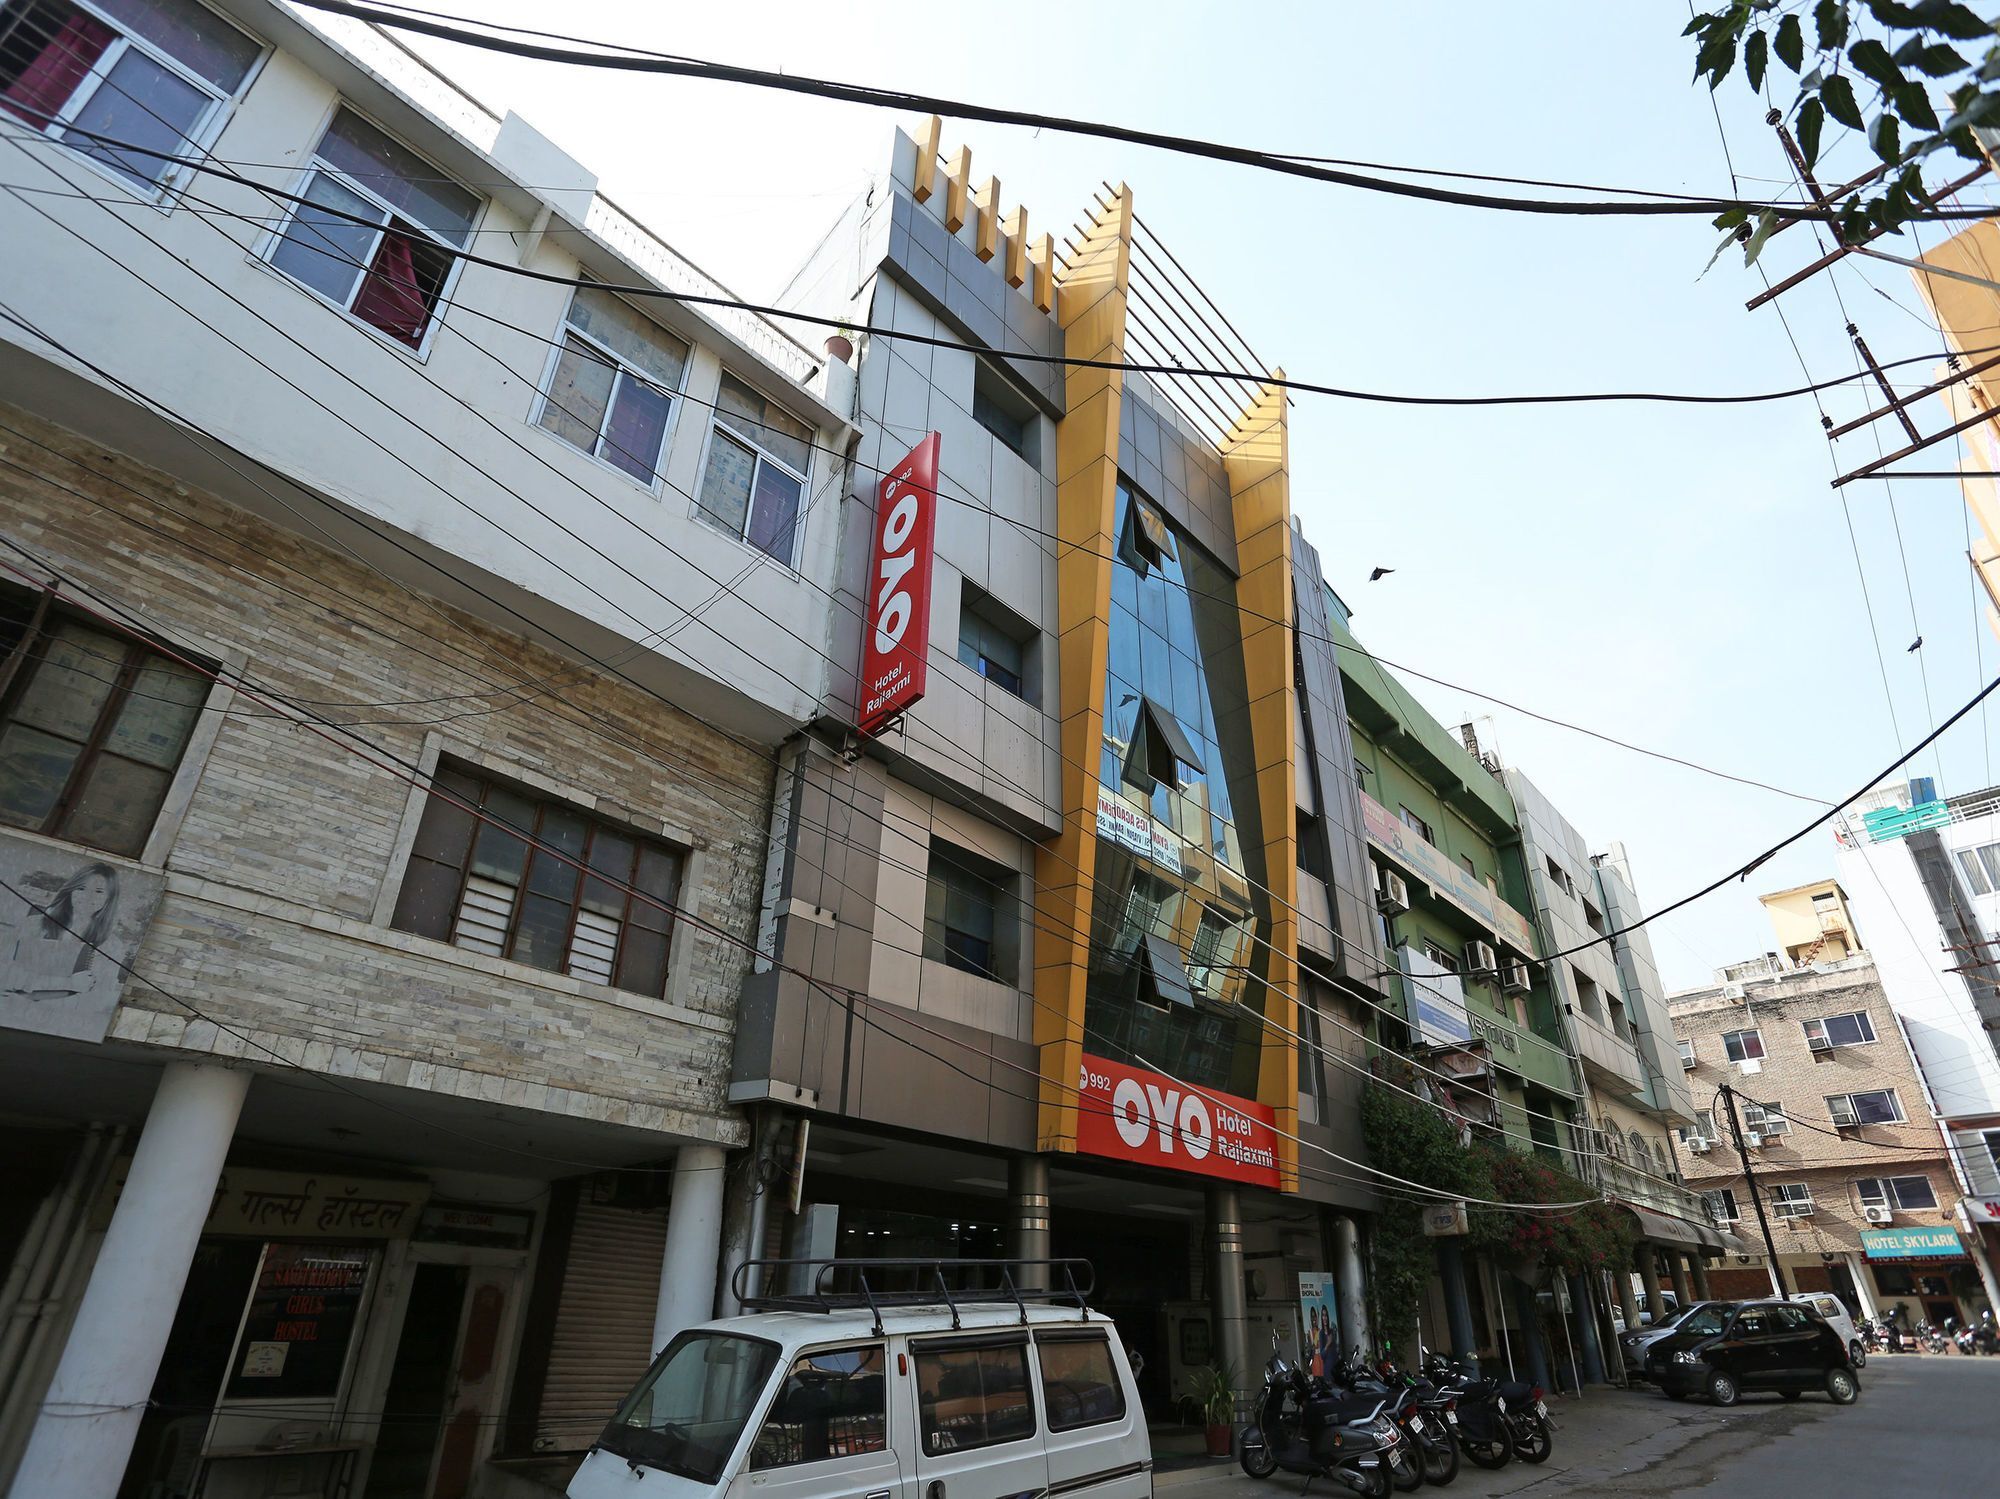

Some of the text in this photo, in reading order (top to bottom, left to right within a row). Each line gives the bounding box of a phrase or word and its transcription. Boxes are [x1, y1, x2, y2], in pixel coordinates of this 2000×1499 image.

[897, 466, 913, 487] 992
[874, 494, 919, 655] OYO
[874, 660, 902, 692] Hotel
[866, 671, 911, 715] Rajlaxmi
[1090, 1072, 1111, 1091] 992
[1113, 1078, 1212, 1160] OYO
[1216, 1108, 1252, 1137] Hotel
[1217, 1136, 1273, 1168] Rajlaxmi
[1866, 1234, 1958, 1250] HOTEL SKYLARK
[287, 1295, 325, 1314] GIRLS
[273, 1321, 319, 1341] HOSTEL
